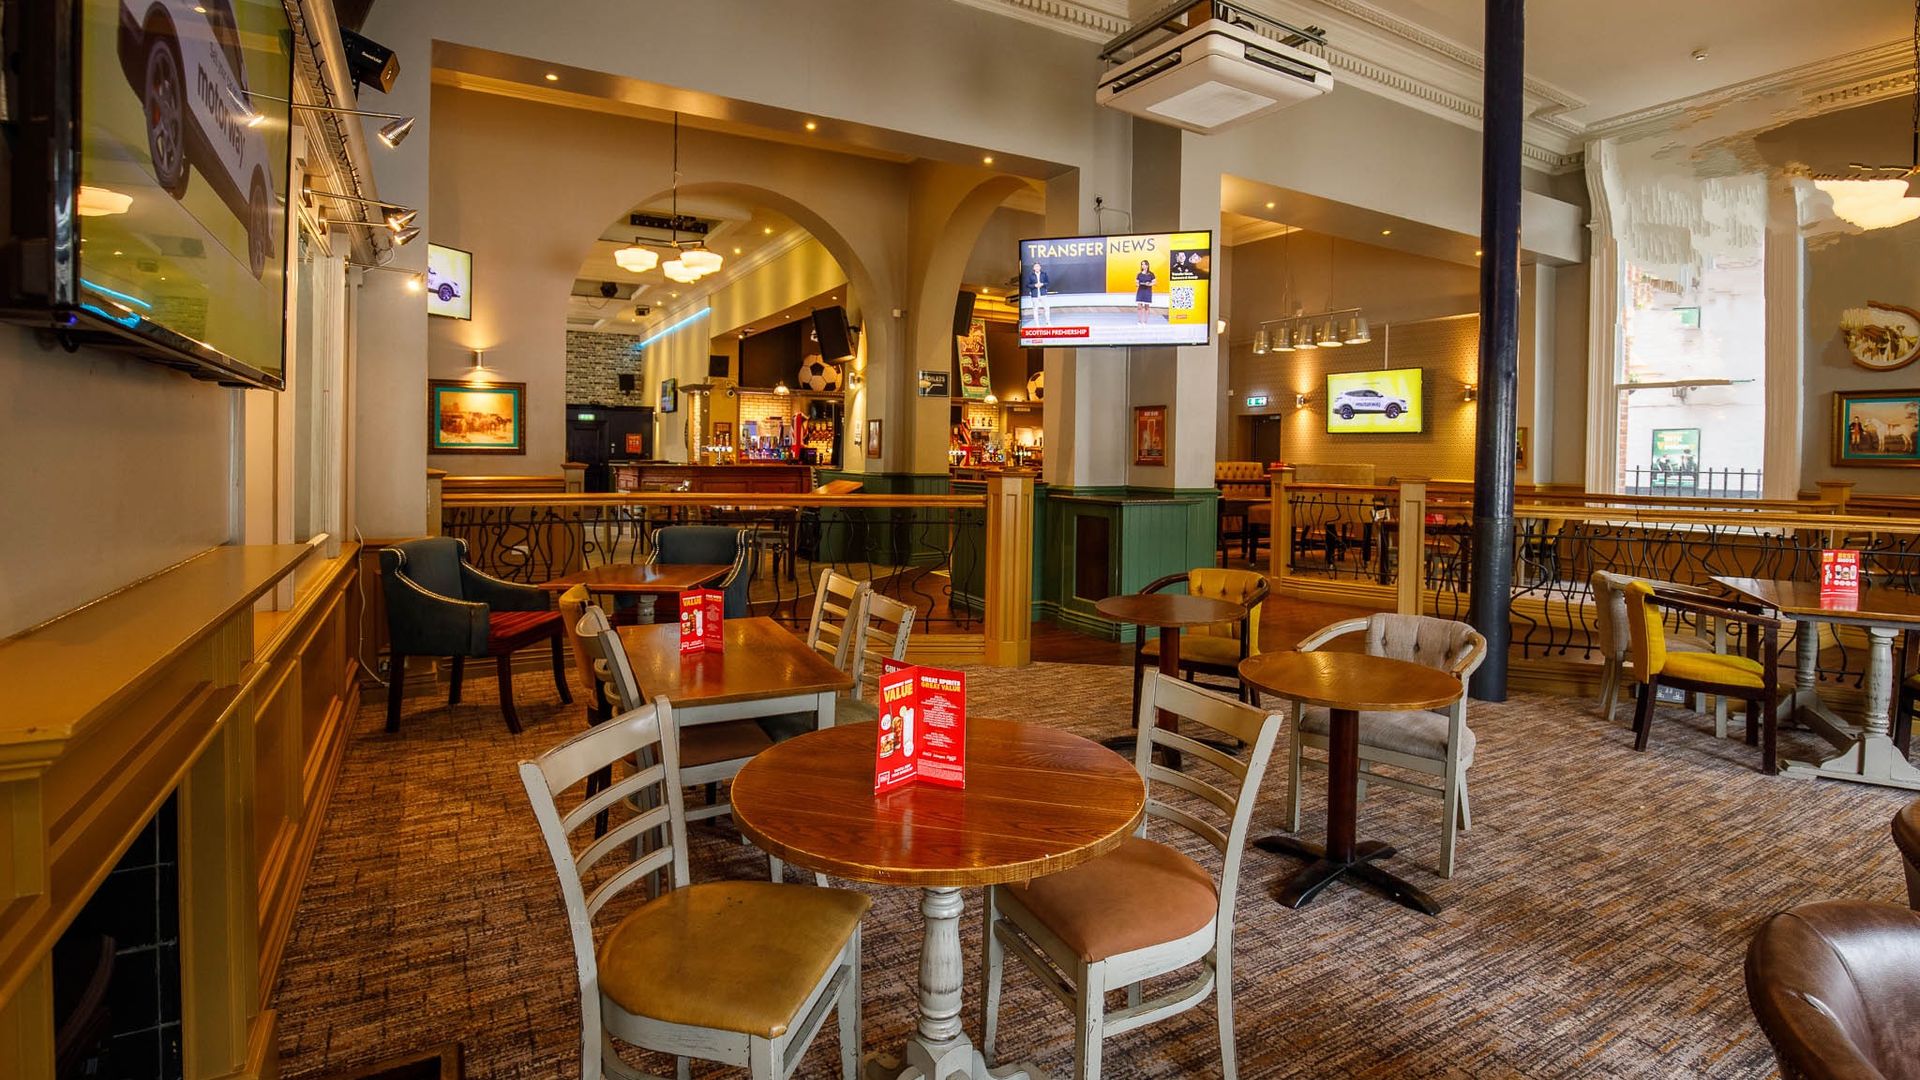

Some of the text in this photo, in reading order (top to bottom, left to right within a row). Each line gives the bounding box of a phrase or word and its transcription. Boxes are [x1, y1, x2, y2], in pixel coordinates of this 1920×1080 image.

[197, 62, 247, 168] motorway
[1028, 238, 1156, 258] TRANSFER NEWS
[883, 683, 913, 704] VALUE
[920, 682, 940, 690] GREAT
[941, 684, 961, 692] VALUE
